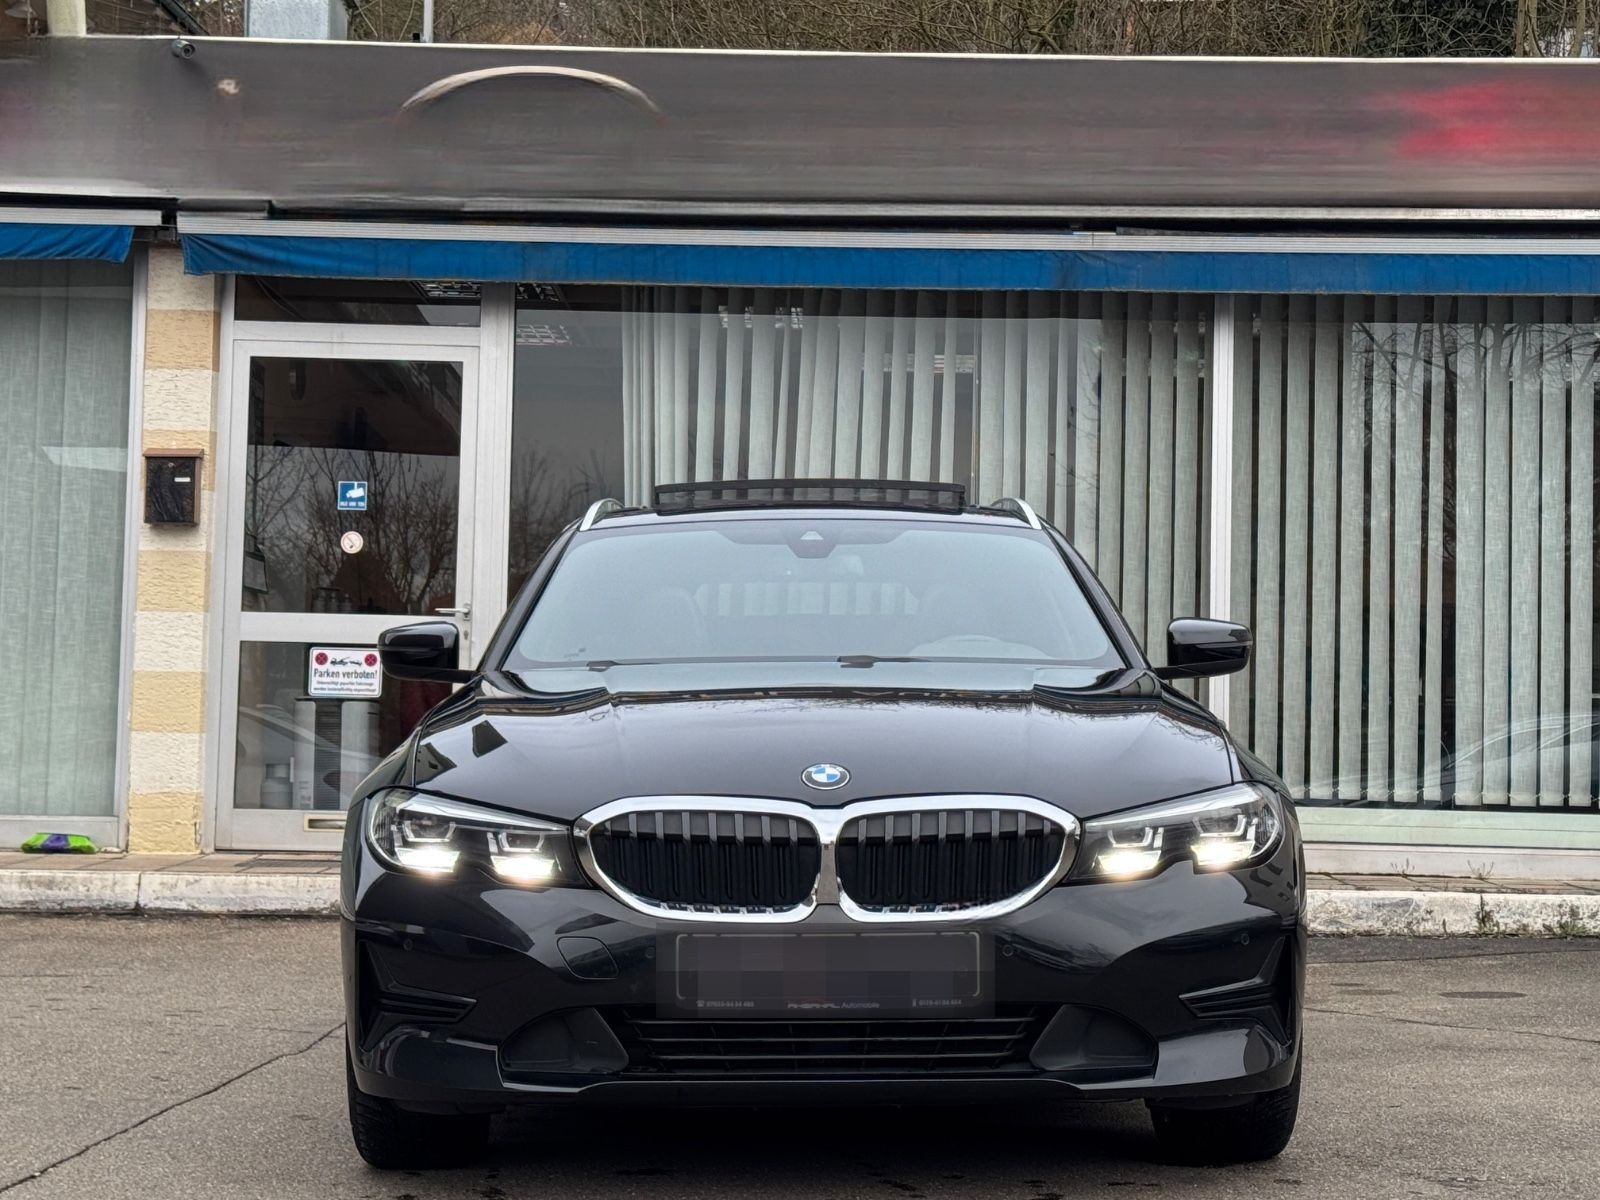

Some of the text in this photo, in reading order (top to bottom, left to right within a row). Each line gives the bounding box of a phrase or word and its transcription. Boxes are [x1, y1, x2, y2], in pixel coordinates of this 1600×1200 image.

[313, 668, 378, 679] Parken verboten!
[841, 1001, 880, 1009] Automobile
